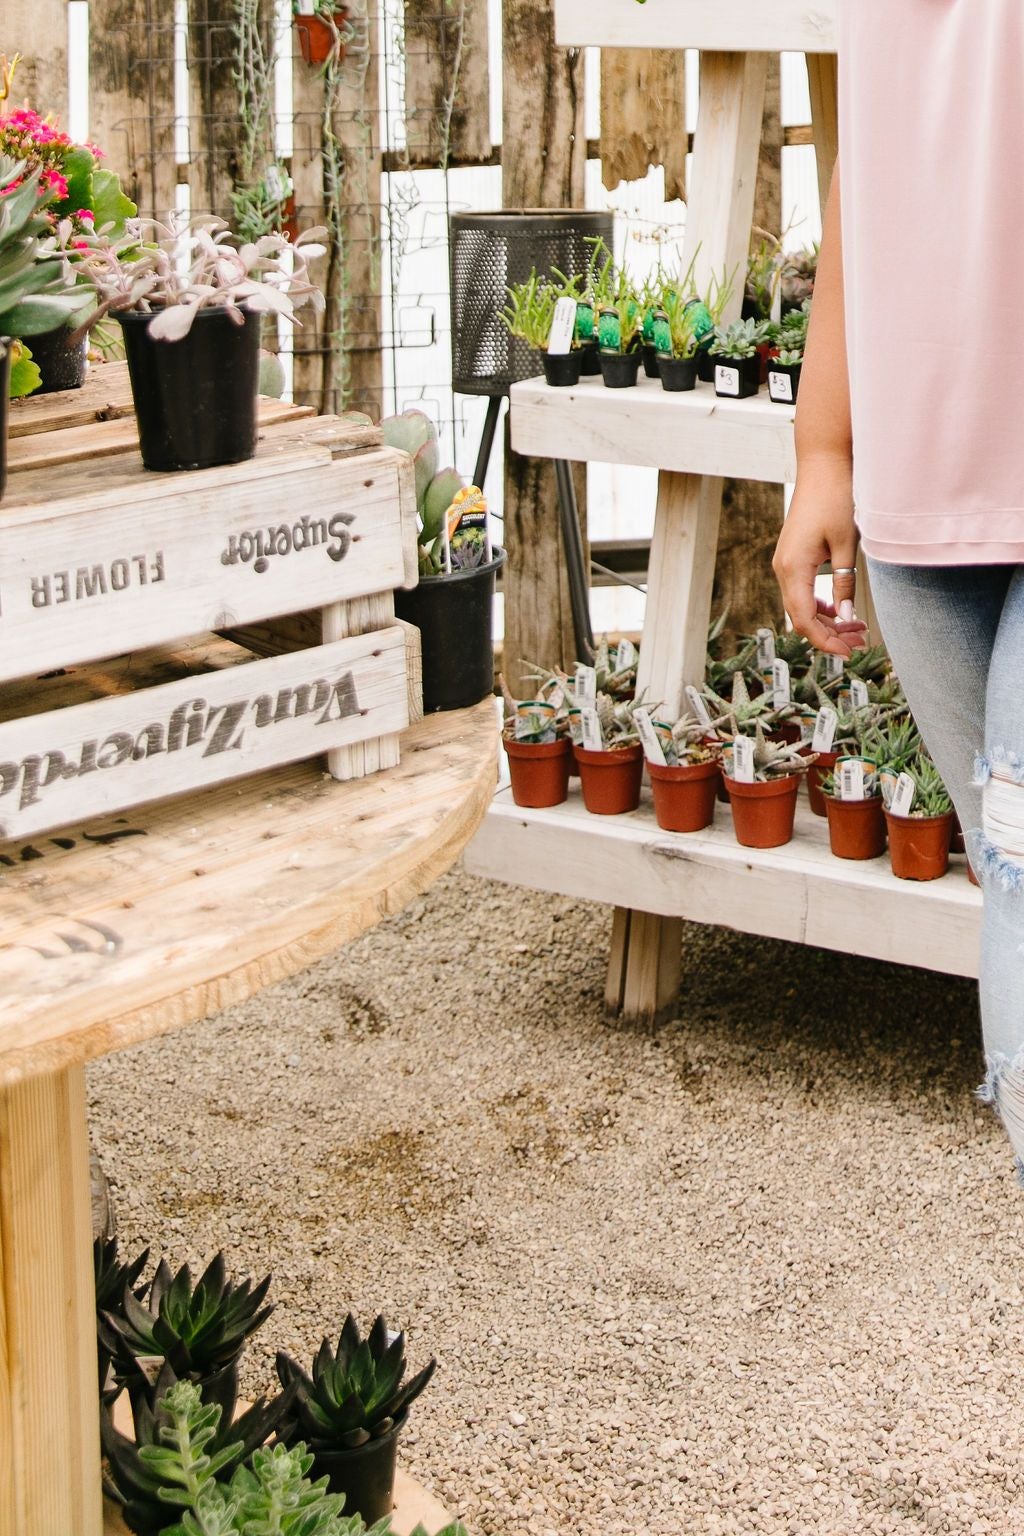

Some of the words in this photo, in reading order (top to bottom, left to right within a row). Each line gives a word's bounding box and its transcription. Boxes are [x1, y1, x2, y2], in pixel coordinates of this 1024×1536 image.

[720, 369, 734, 386] $3
[773, 374, 787, 393] $3
[222, 512, 356, 575] Superior
[31, 551, 166, 608] FLOWER
